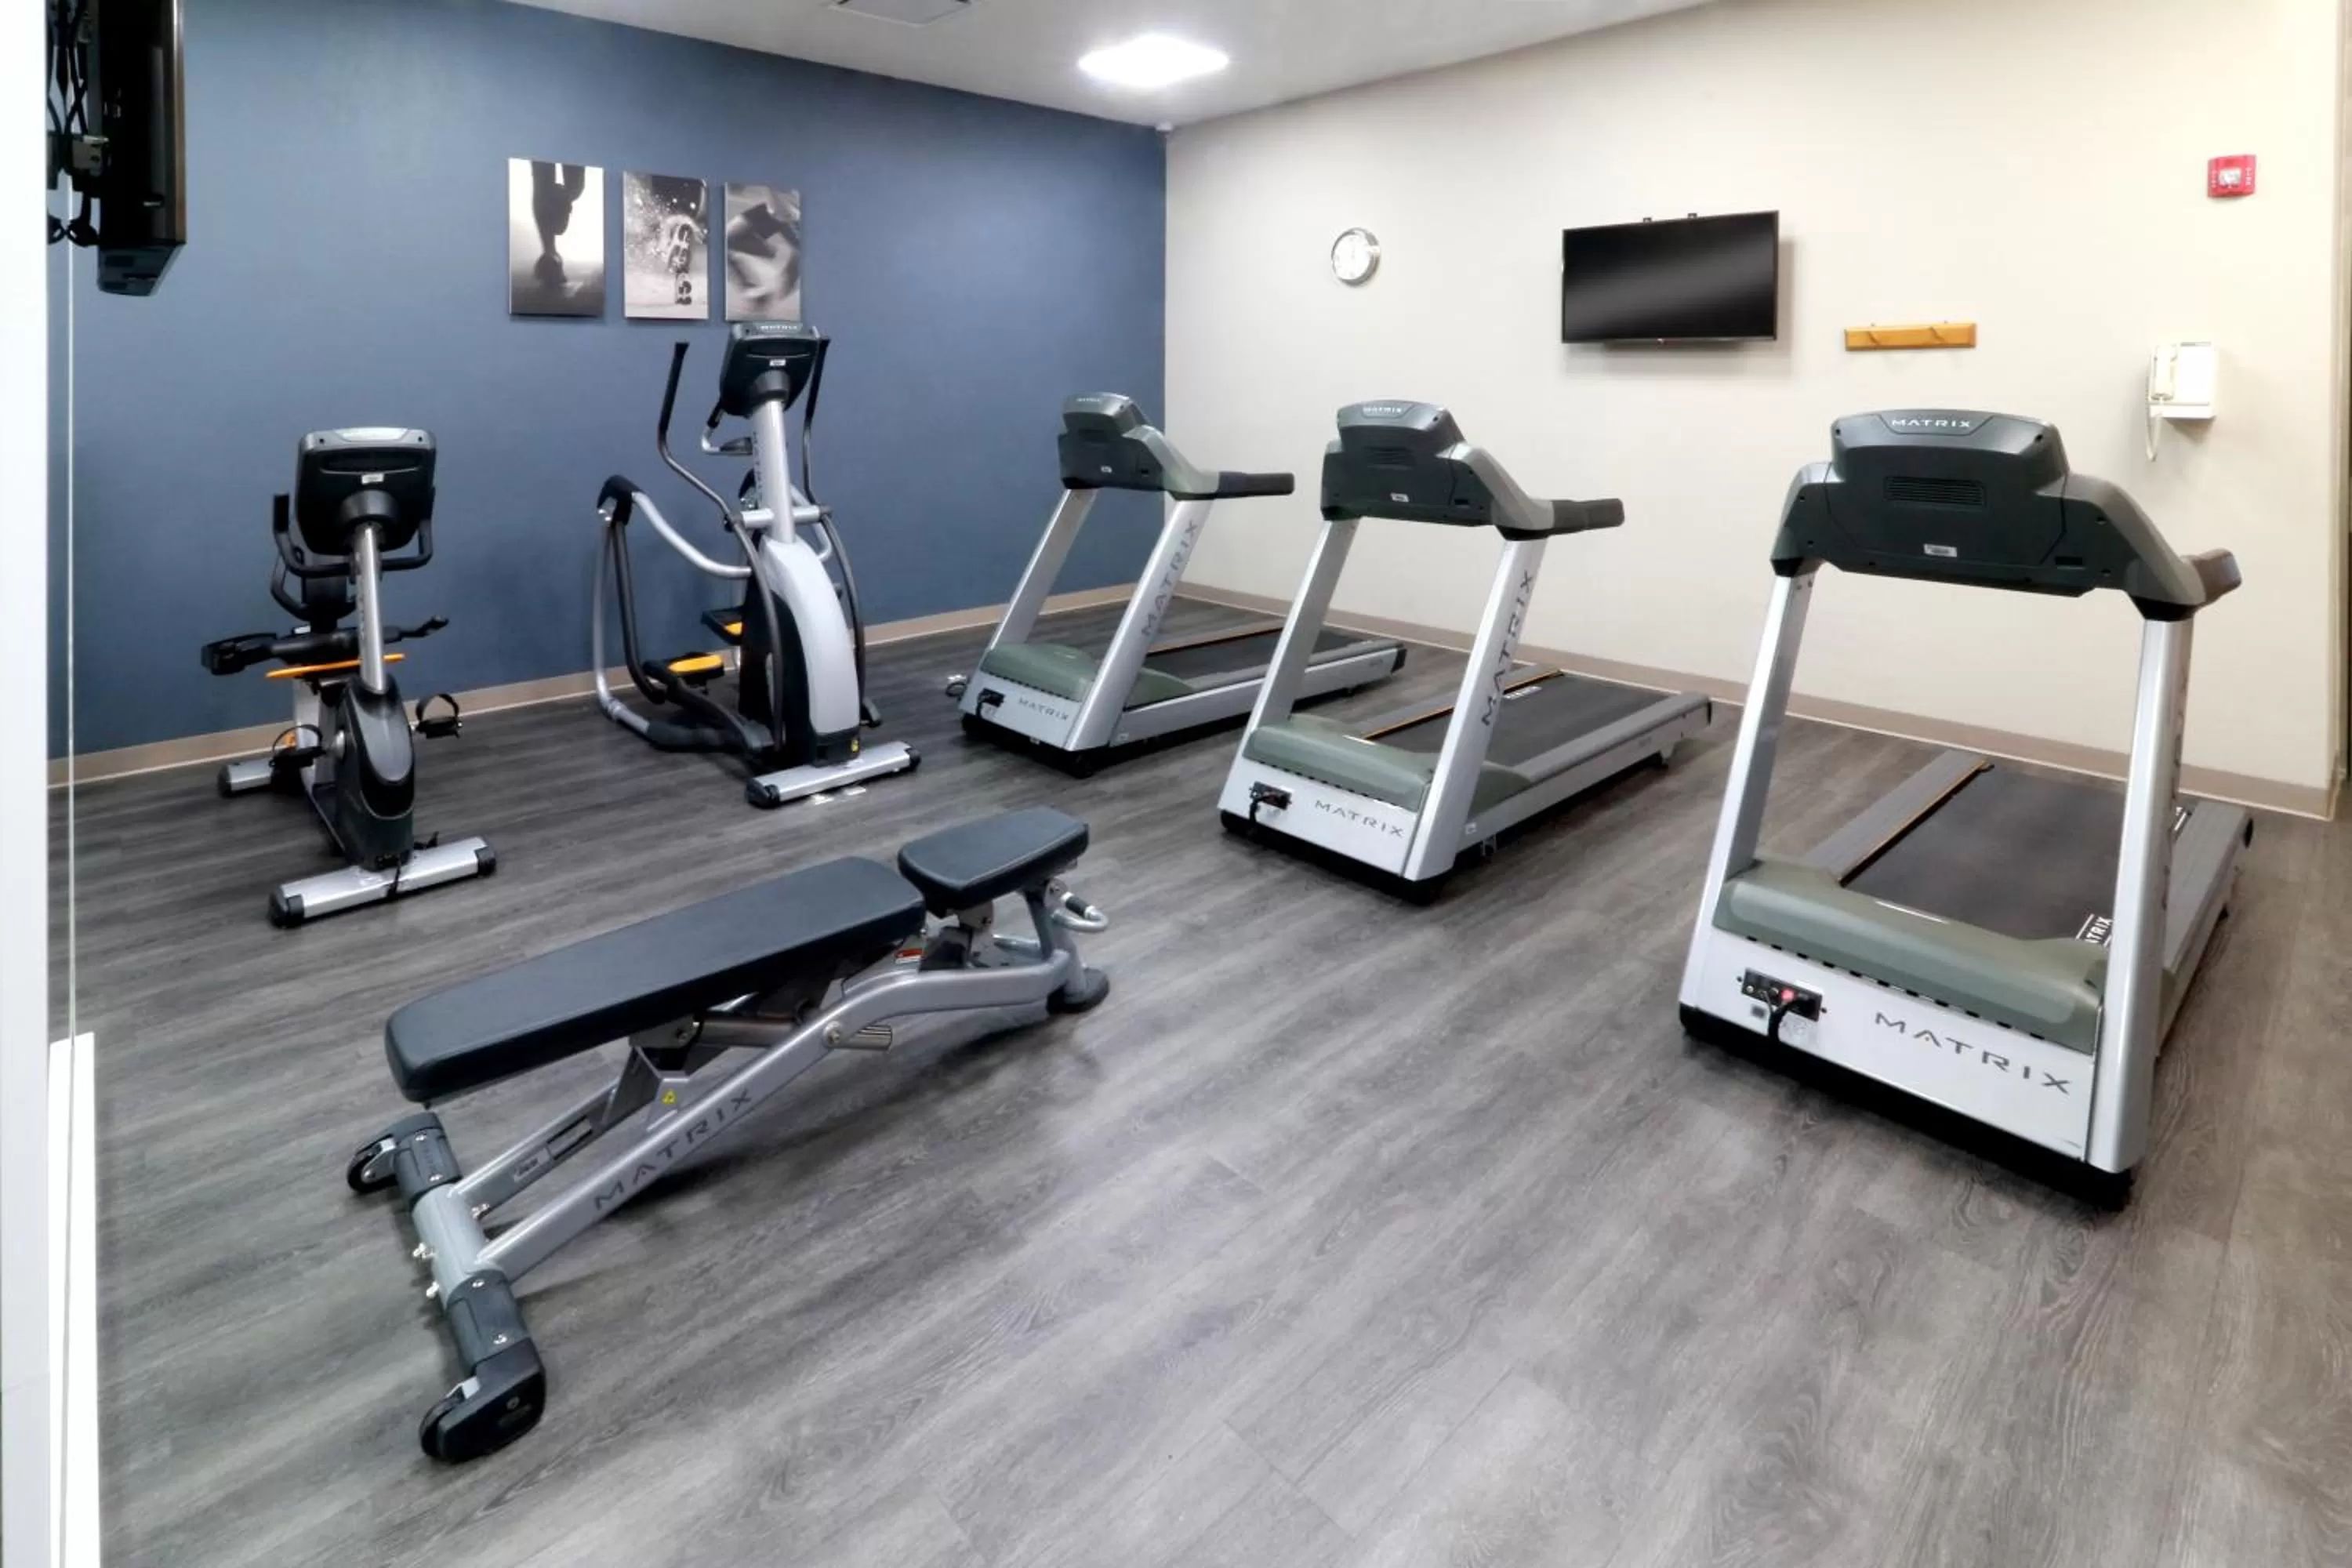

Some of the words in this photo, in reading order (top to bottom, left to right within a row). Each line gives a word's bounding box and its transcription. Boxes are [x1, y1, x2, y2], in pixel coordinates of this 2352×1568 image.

[1142, 520, 1198, 636] MATRIX
[1481, 570, 1533, 726] MATRIX
[1315, 800, 1404, 838] MATRIX
[1875, 1012, 2071, 1095] MATRIX
[594, 1087, 751, 1210] MATRIX
